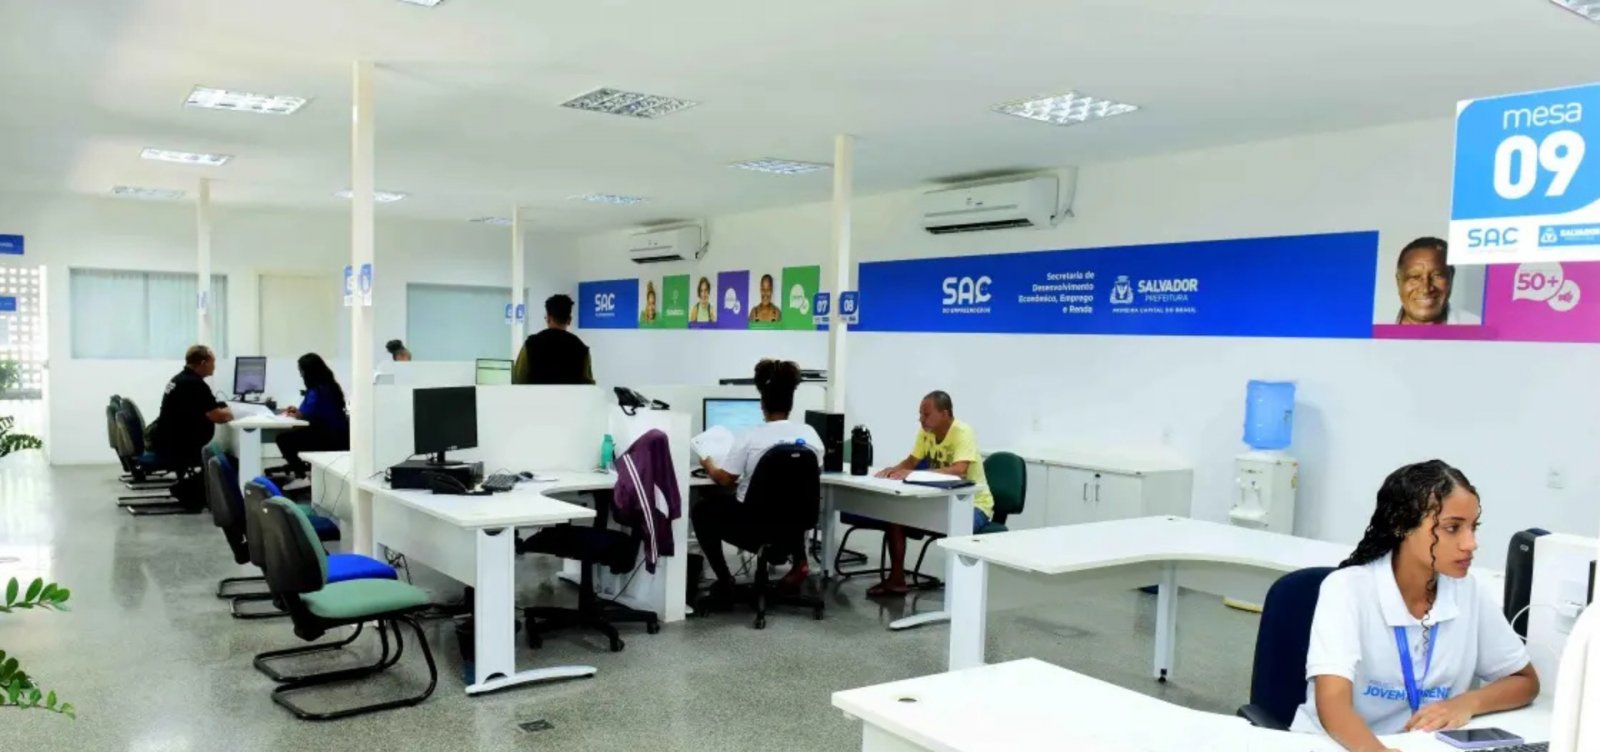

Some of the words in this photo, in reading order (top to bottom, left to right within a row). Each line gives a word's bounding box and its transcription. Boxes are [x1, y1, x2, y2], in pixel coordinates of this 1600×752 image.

[1503, 102, 1583, 130] mesa
[1493, 130, 1586, 200] 09
[1467, 227, 1519, 248] SAC
[1047, 272, 1083, 281] Secretaria
[1084, 271, 1095, 279] de
[1517, 272, 1559, 291] 50+
[942, 276, 992, 305] SAC
[1032, 283, 1094, 292] Desenvolvimento
[1137, 278, 1199, 293] SALVADOR
[595, 293, 615, 312] SAC
[844, 300, 854, 312] 08
[1059, 294, 1094, 303] Emprego
[817, 301, 828, 314] 07
[1069, 305, 1093, 313] Renda
[1363, 685, 1406, 701] JOVEM
